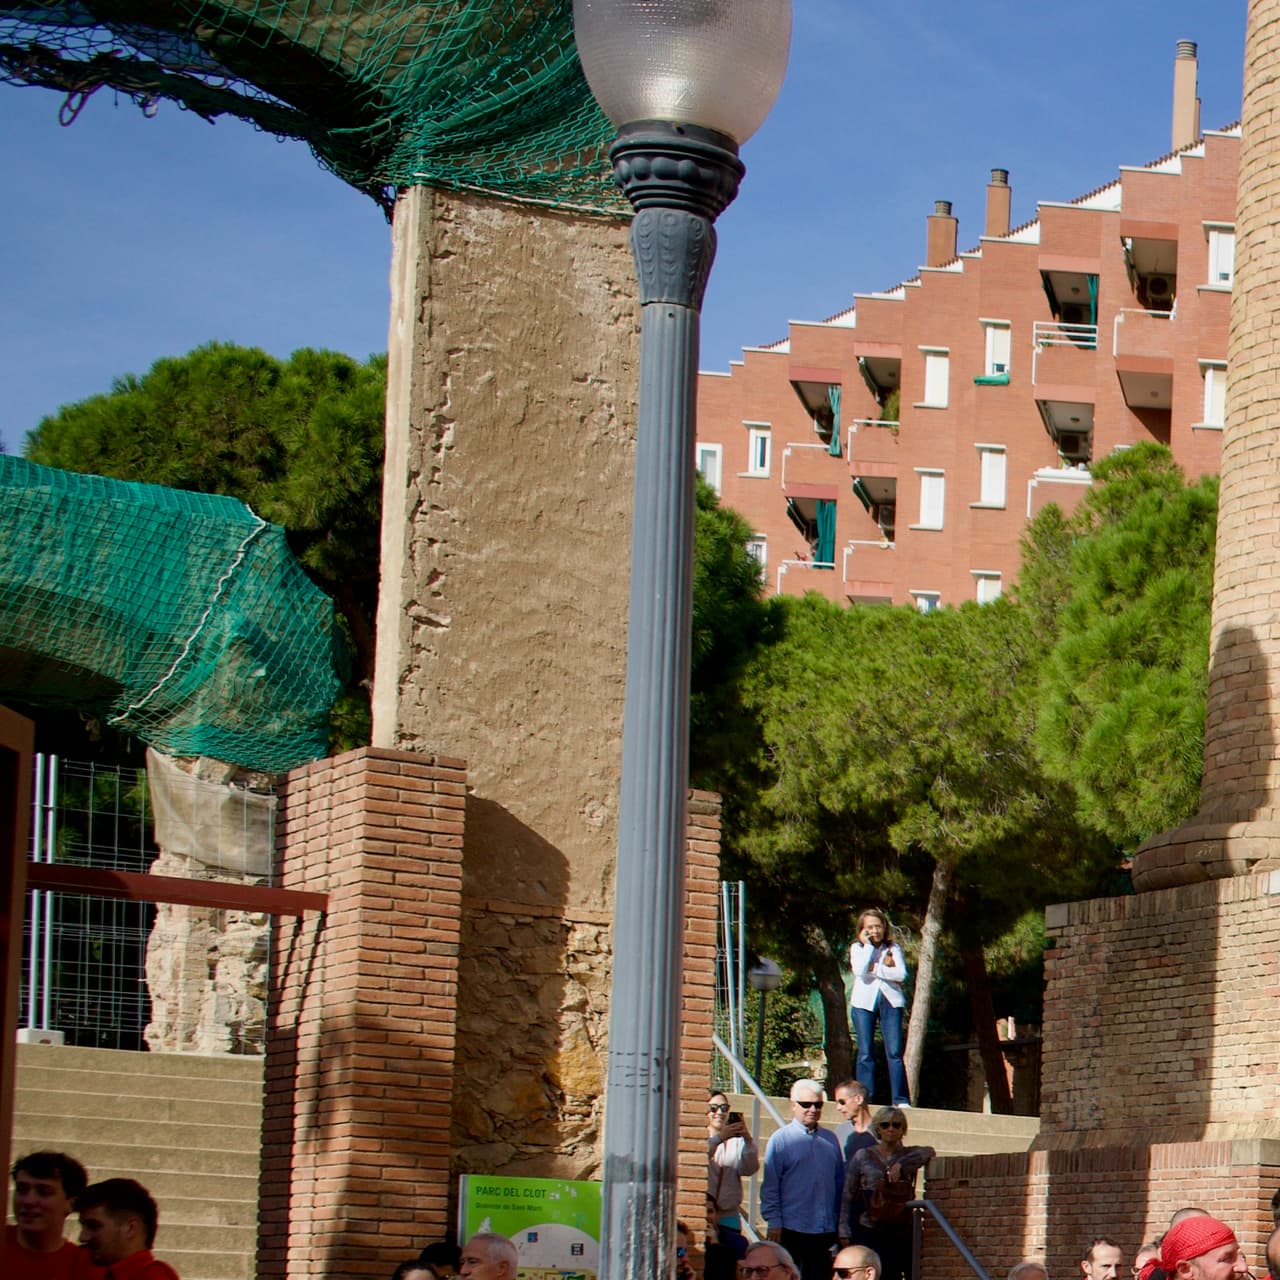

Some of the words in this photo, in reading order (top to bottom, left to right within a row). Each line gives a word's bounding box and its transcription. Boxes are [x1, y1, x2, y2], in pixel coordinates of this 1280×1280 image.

[475, 1186, 501, 1196] PARC
[503, 1187, 521, 1198] DEL
[523, 1188, 547, 1199] CLOT
